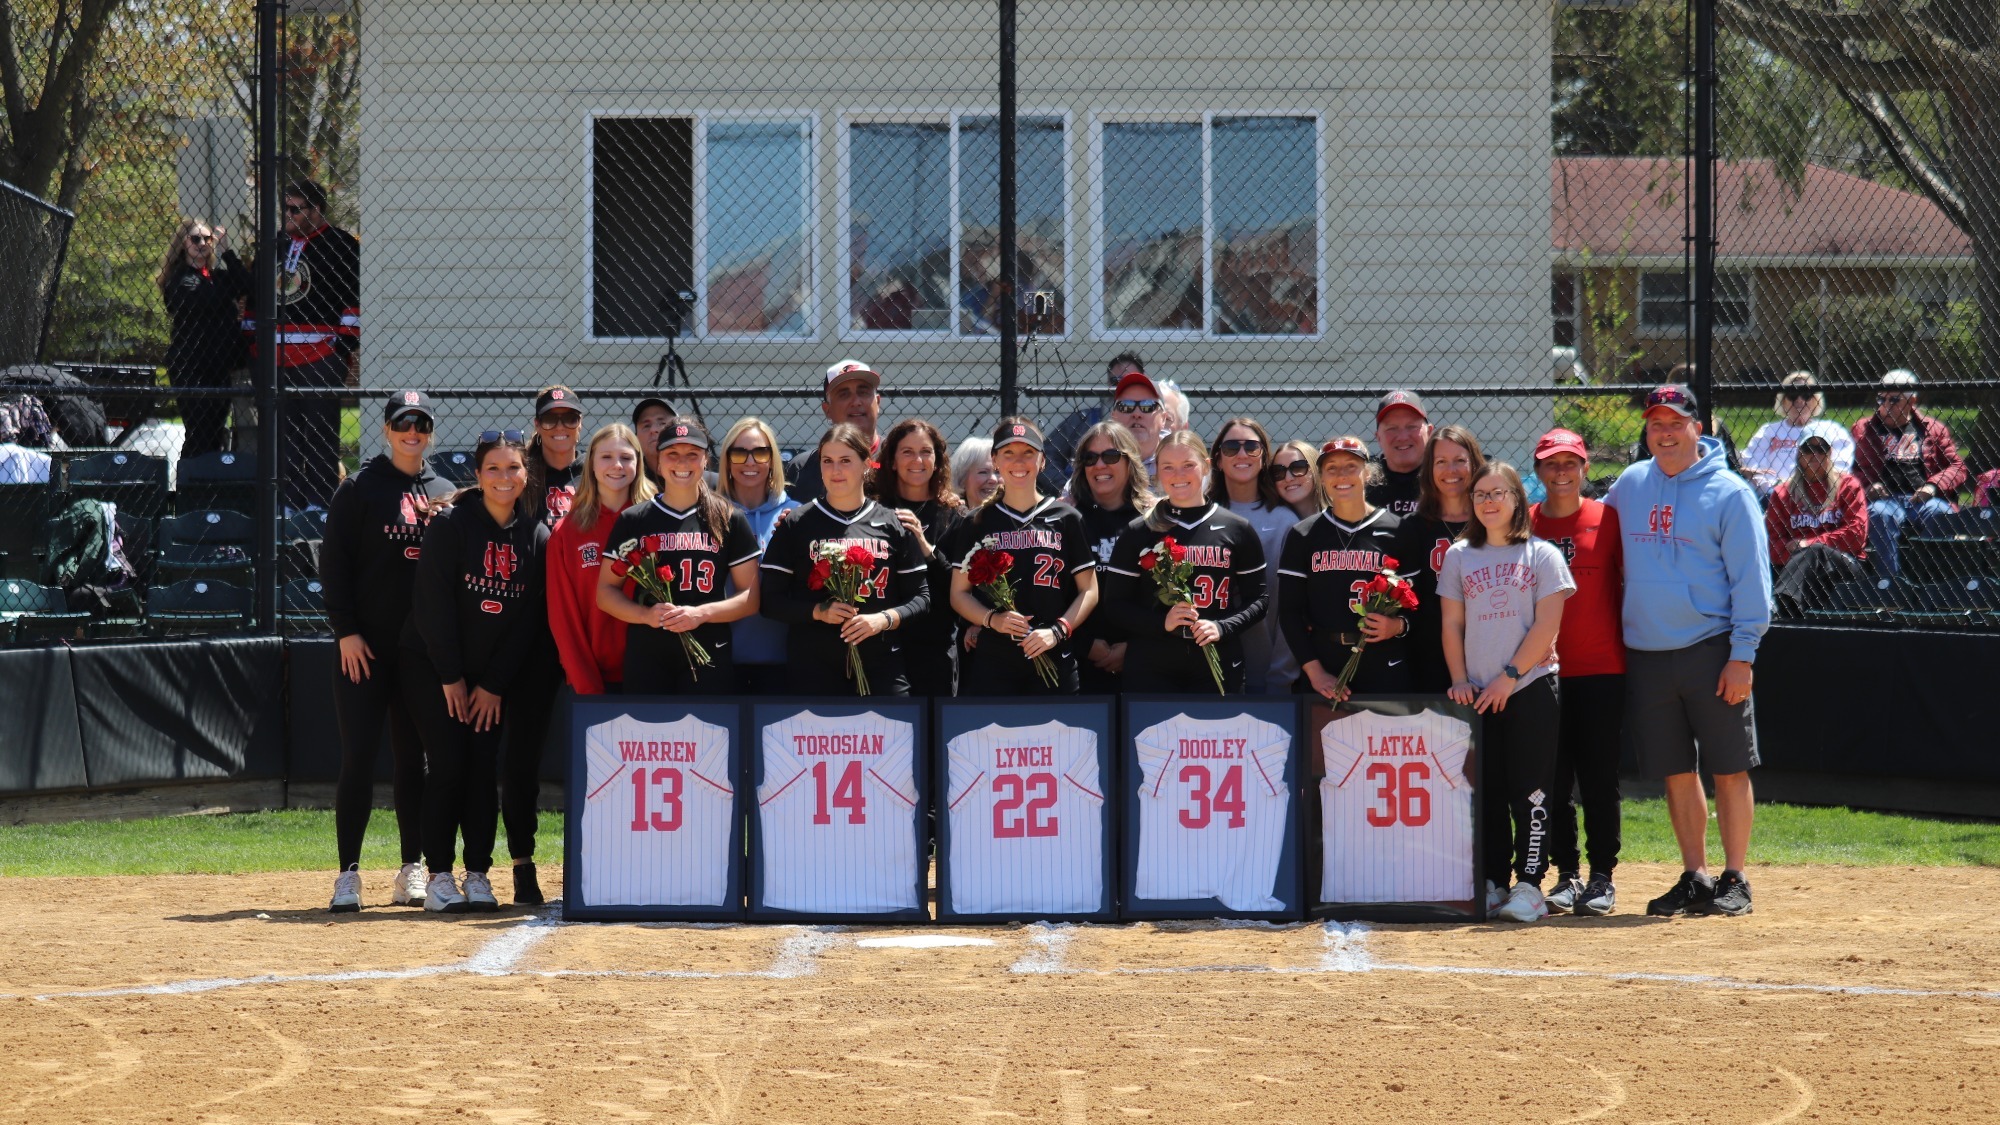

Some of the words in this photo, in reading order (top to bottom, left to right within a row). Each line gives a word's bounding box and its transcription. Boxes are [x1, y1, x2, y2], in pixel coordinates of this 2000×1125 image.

[383, 525, 425, 535] CARDI
[640, 532, 720, 554] RDINALS
[809, 538, 890, 561] CDIALS
[1184, 545, 1231, 569] INALS
[1312, 550, 1386, 573] CARDINAL
[679, 558, 716, 593] 13
[1192, 575, 1231, 609] 34
[1469, 577, 1528, 600] COLLEGE
[618, 741, 697, 763] WARREN
[793, 735, 884, 756] TOROSIAN
[1178, 738, 1247, 760] DOOLEY
[1367, 735, 1428, 757] LATKA
[995, 747, 1053, 769] LYNCH
[631, 767, 684, 832] 13
[812, 760, 867, 825] 14
[1178, 764, 1247, 830] 34
[1366, 761, 1432, 828] 36
[992, 772, 1060, 839] 22
